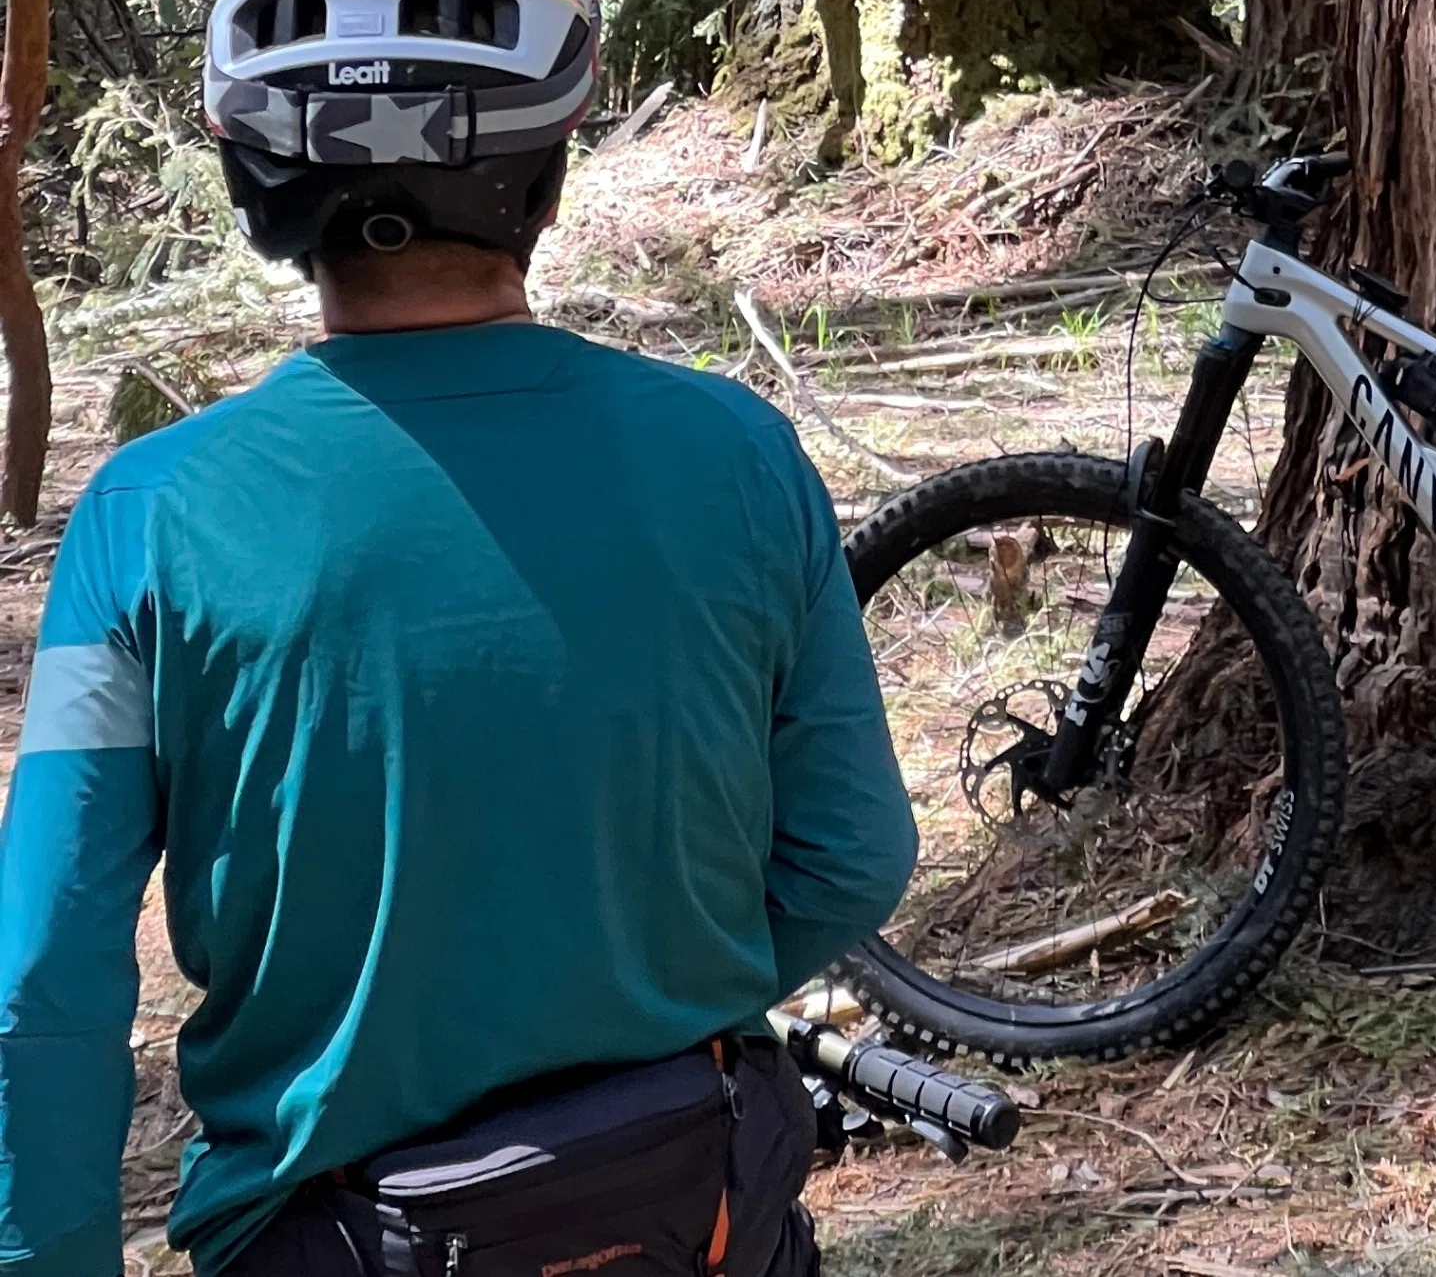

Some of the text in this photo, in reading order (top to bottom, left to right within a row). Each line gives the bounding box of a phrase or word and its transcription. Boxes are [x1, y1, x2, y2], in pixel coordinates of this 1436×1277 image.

[328, 60, 391, 86] Leatt
[1253, 789, 1295, 895] DT SWISS
